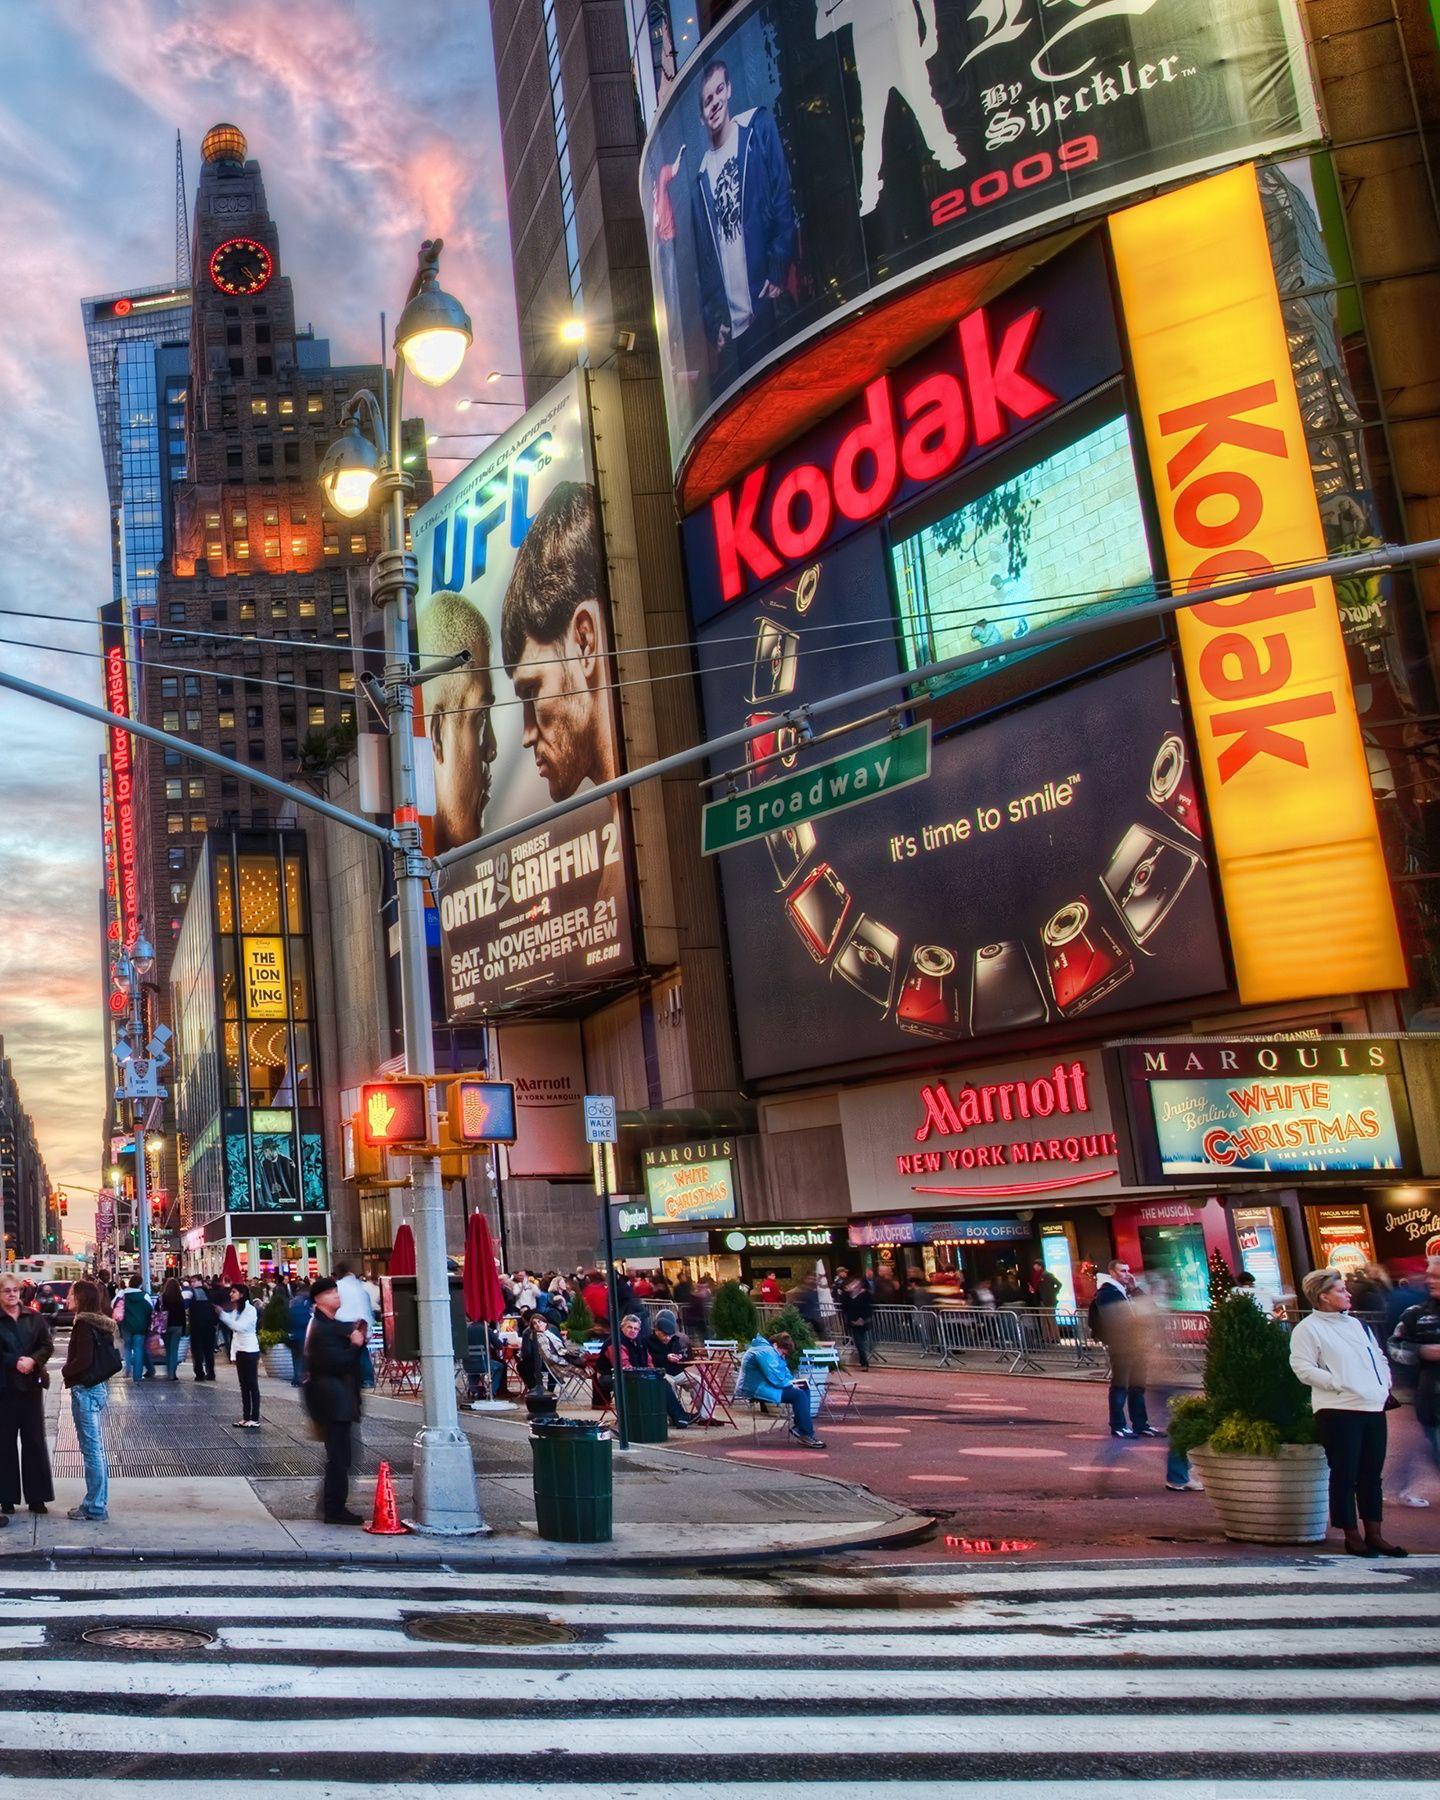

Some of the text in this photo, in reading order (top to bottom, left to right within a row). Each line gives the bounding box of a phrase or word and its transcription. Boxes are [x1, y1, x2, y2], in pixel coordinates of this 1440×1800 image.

[981, 80, 1023, 115] By
[930, 134, 1099, 227] 2009
[415, 395, 570, 538] ULTIMATE FIGHTING CHAMPIONSHIP
[709, 306, 1058, 602] Kodak
[431, 430, 553, 595] UFC
[1158, 380, 1337, 785] Kodak
[109, 645, 130, 770] Macovision
[116, 773, 132, 803] for
[734, 753, 892, 832] Broadway
[117, 805, 135, 865] name
[890, 834, 917, 862] it's
[922, 818, 970, 852] time
[975, 808, 1001, 832] to
[475, 832, 550, 880] TITO FORREST
[123, 868, 137, 916] new
[441, 876, 496, 932] ORTIZ
[511, 830, 599, 904] GRIFFIN
[601, 823, 620, 866] 2
[451, 947, 484, 975] SAT.
[487, 907, 590, 959] NOVEMBER
[593, 897, 617, 920] 21
[252, 952, 275, 964] THE
[452, 972, 480, 992] LIVE
[483, 962, 505, 981] ON
[509, 919, 619, 973] PAY-PER-VIEW
[586, 943, 621, 966] UFC.COM
[249, 967, 280, 986] LION
[250, 988, 282, 1008] KING
[1143, 1047, 1385, 1072] MARQUIS
[516, 1077, 571, 1091] Marriott
[1227, 1080, 1330, 1118] WHITE
[914, 1060, 1090, 1142] Marriott
[1161, 1096, 1208, 1122] Irving
[1182, 1103, 1237, 1132] Berlin's
[645, 1141, 731, 1165] MARQUIS
[1203, 1109, 1381, 1165] CHRISTMAS
[1302, 1147, 1347, 1158] MUSICAL
[672, 1165, 709, 1187] WHITE
[896, 1152, 941, 1176] NEW
[946, 1145, 1007, 1170] YORK
[665, 1180, 727, 1217] CHRISTMAS
[1141, 1206, 1194, 1219] THE MUSICAL
[871, 1227, 885, 1241] BOX
[886, 1226, 912, 1239] OFFICE
[966, 1227, 989, 1237] BOX
[991, 1225, 1030, 1236] OFFICE
[1385, 1208, 1431, 1232] Irving
[1405, 1218, 1440, 1241] Berli
[748, 1230, 832, 1248] sunglass hut
